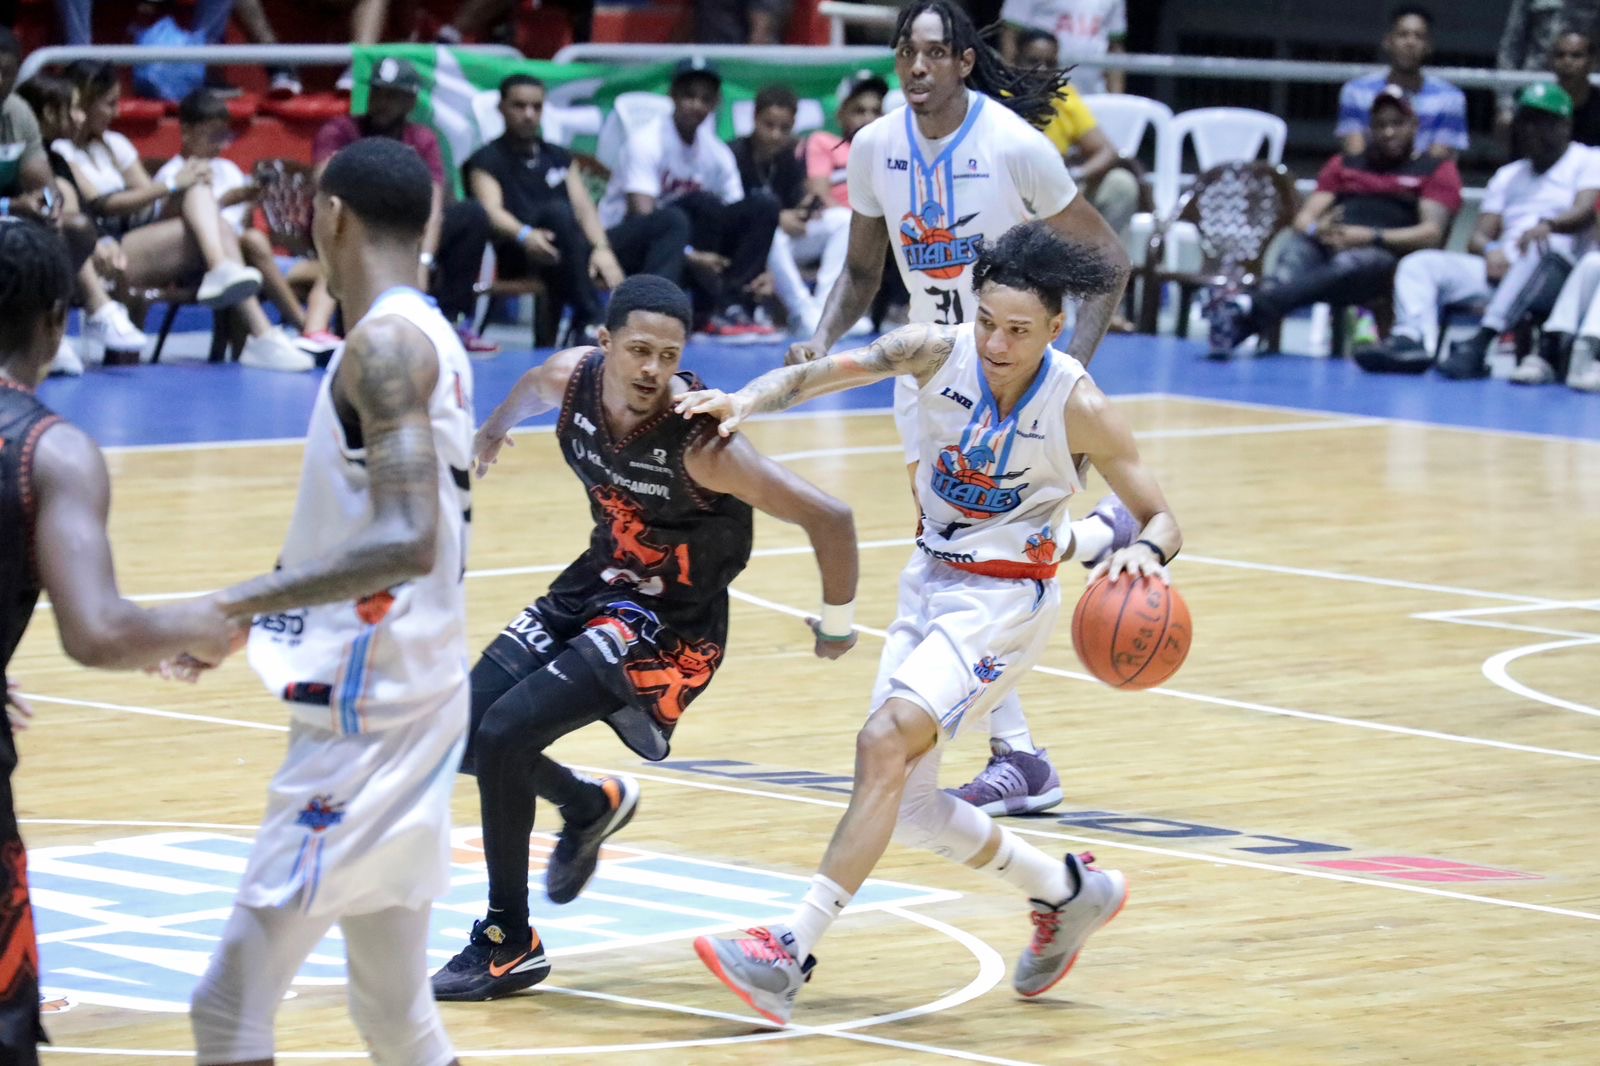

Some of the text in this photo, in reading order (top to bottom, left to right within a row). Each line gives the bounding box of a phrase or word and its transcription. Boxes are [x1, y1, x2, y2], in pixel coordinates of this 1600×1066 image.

[887, 158, 908, 171] LNB
[902, 233, 984, 272] TITANES
[940, 387, 974, 410] LNB
[931, 465, 1030, 513] TITANES
